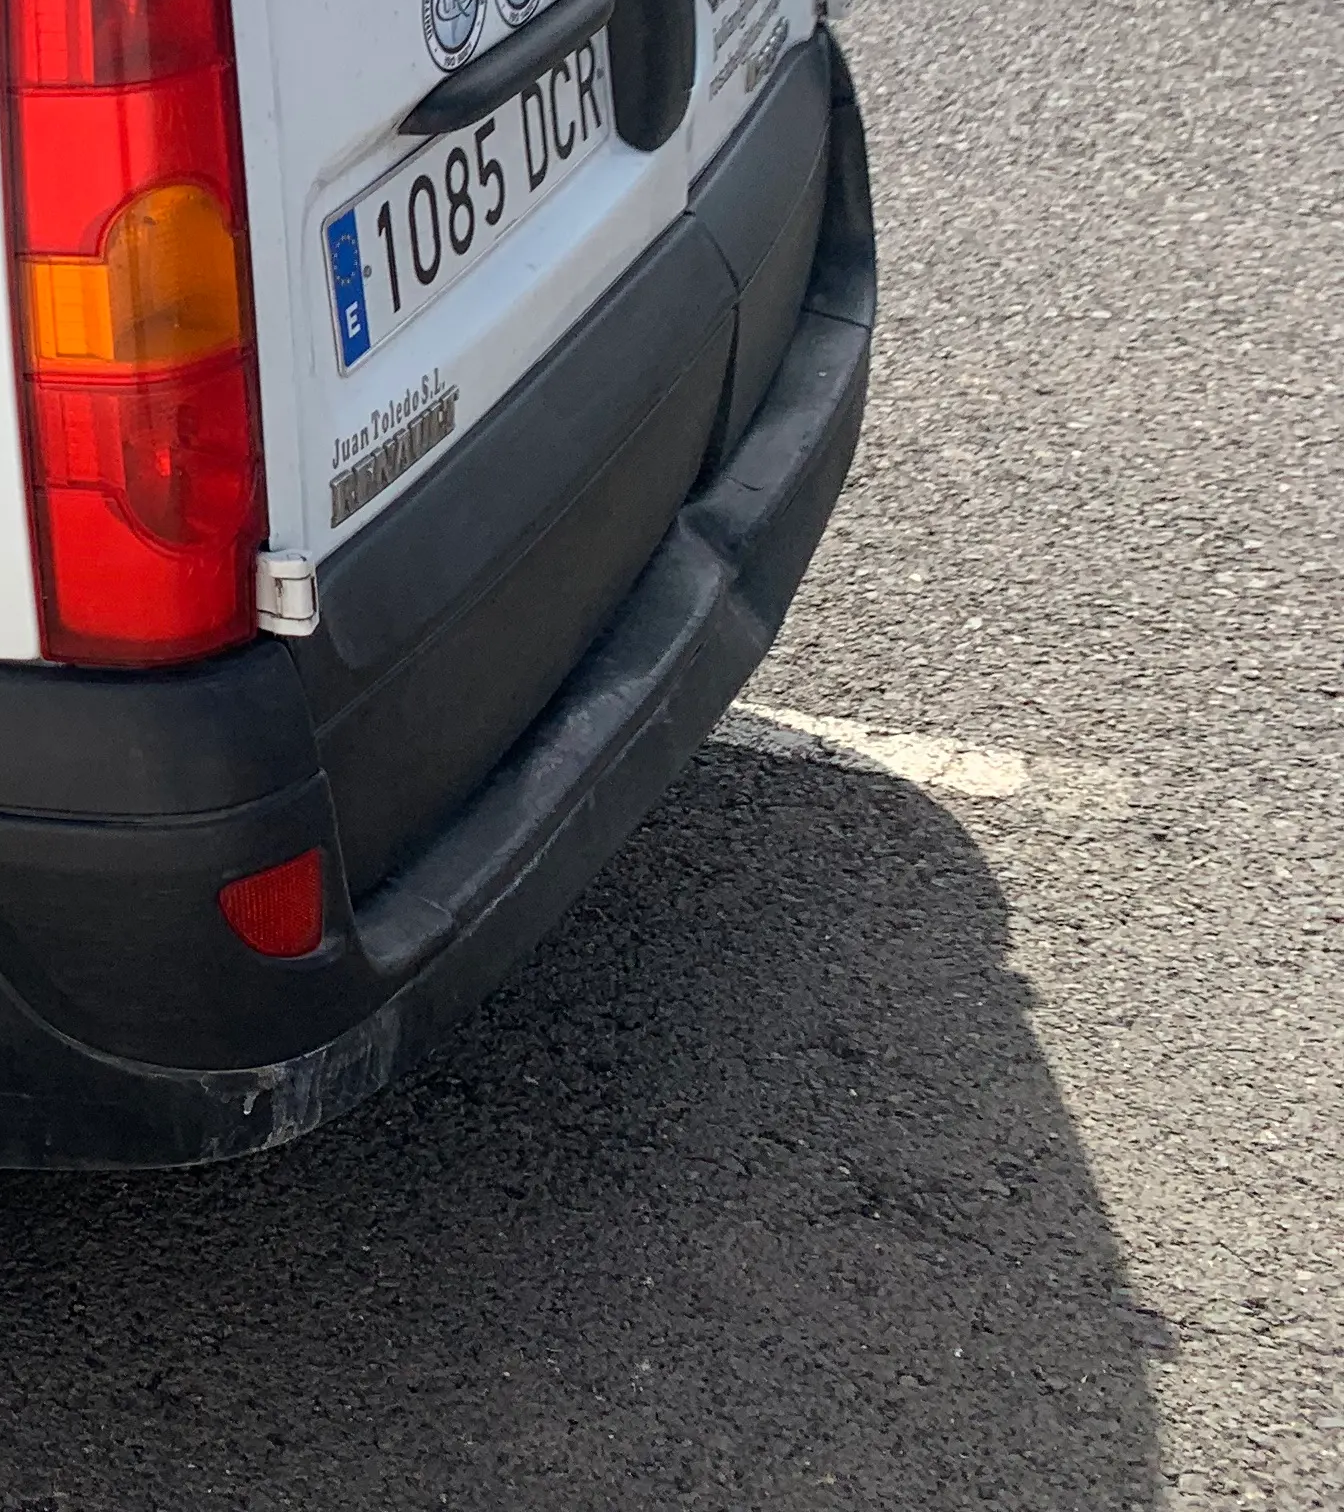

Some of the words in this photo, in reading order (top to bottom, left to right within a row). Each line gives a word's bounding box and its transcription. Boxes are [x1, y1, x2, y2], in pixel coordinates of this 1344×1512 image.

[377, 117, 506, 314] 1085
[520, 39, 603, 192] DCR
[345, 303, 362, 340] E
[332, 425, 370, 470] Juan
[370, 388, 420, 441] Toledo
[420, 367, 446, 405] S.L.
